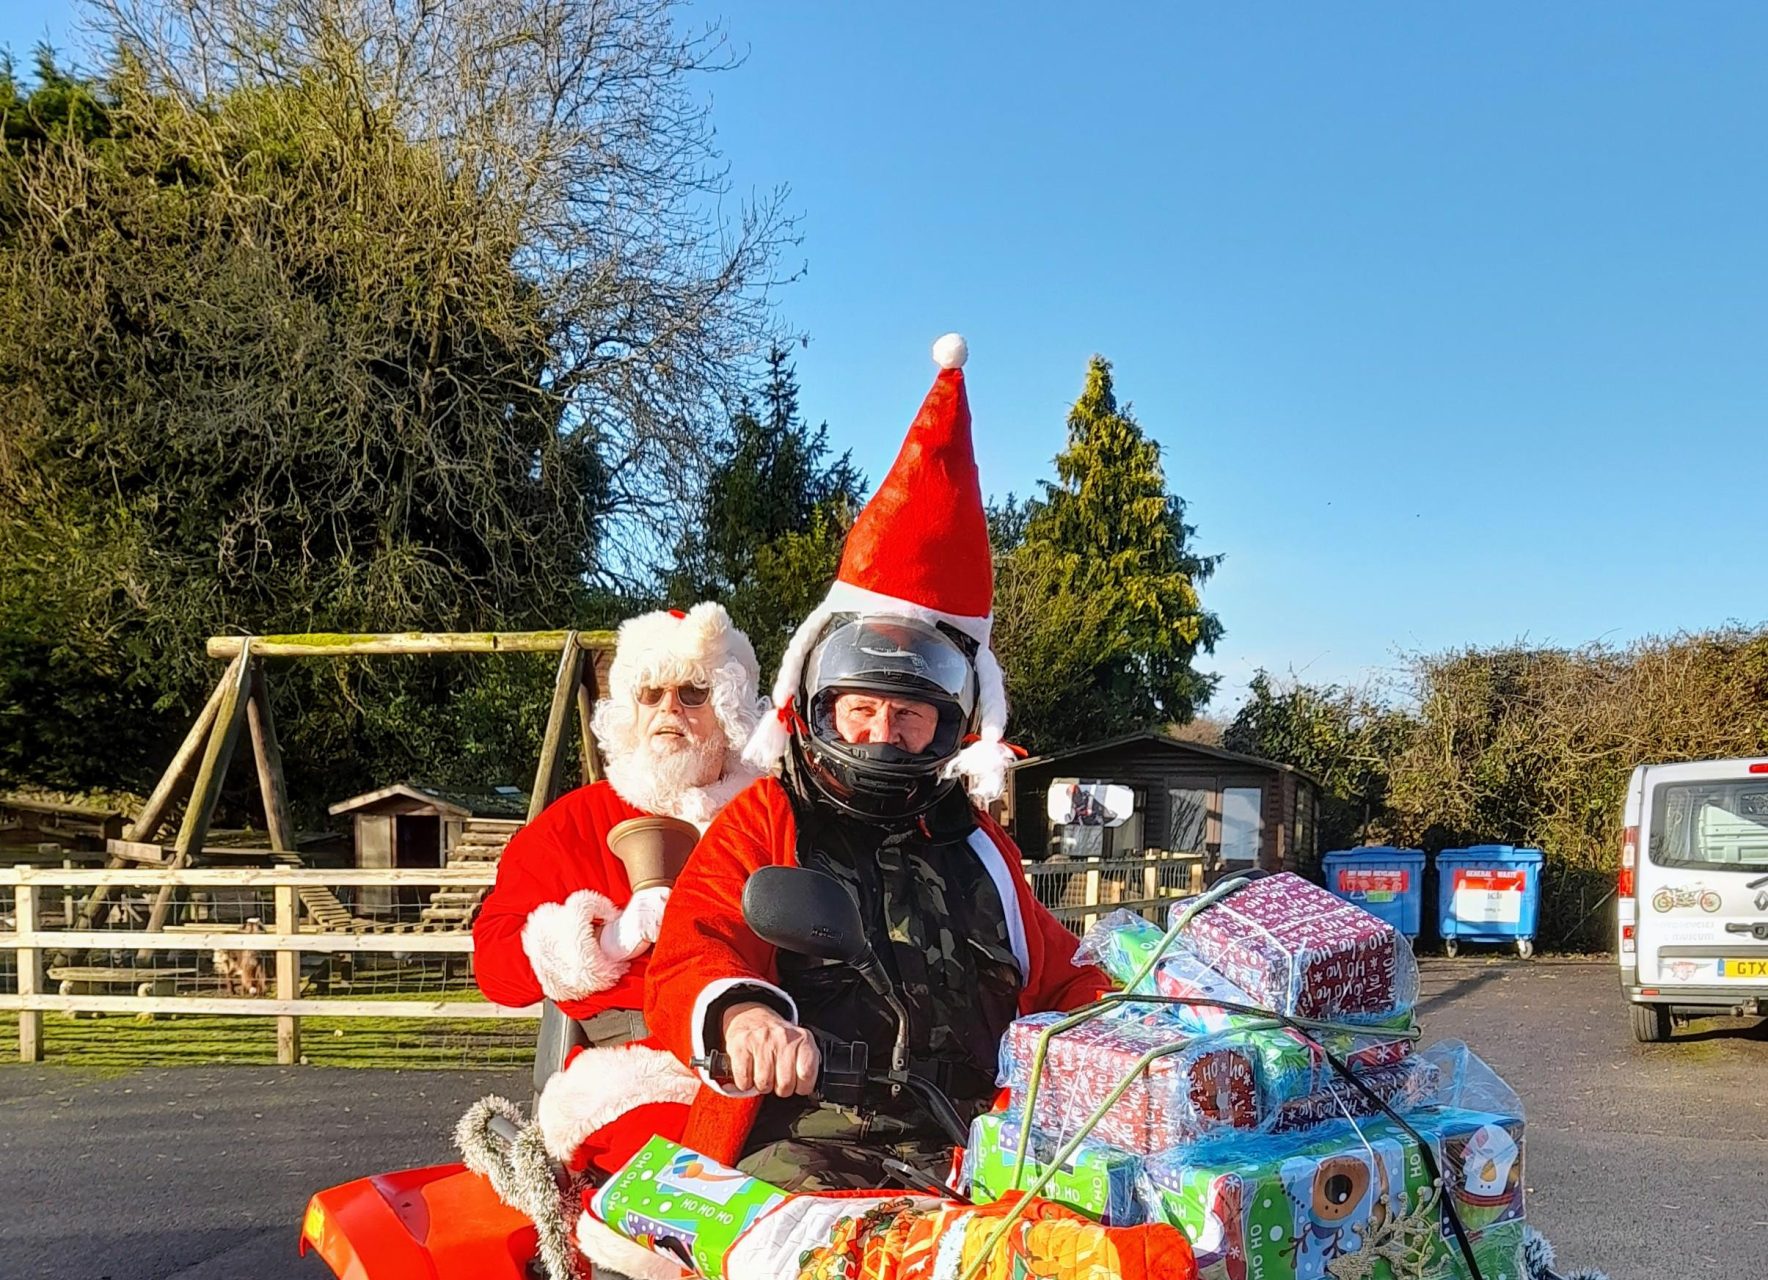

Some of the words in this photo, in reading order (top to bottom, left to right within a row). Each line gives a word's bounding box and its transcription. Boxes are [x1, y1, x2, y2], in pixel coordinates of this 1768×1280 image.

[1369, 929, 1389, 950] HO
[1737, 961, 1767, 975] GTX
[1203, 1061, 1218, 1081] HO
[1410, 1154, 1422, 1178] HO
[608, 1191, 621, 1211] HO
[620, 1171, 637, 1188] HO
[636, 1152, 653, 1169] HO
[1064, 1186, 1080, 1202] HO
[680, 1198, 697, 1212] HO
[699, 1204, 716, 1218] HO
[715, 1211, 734, 1225] HO
[1250, 1224, 1263, 1249] HO
[1252, 1255, 1264, 1280] HO
